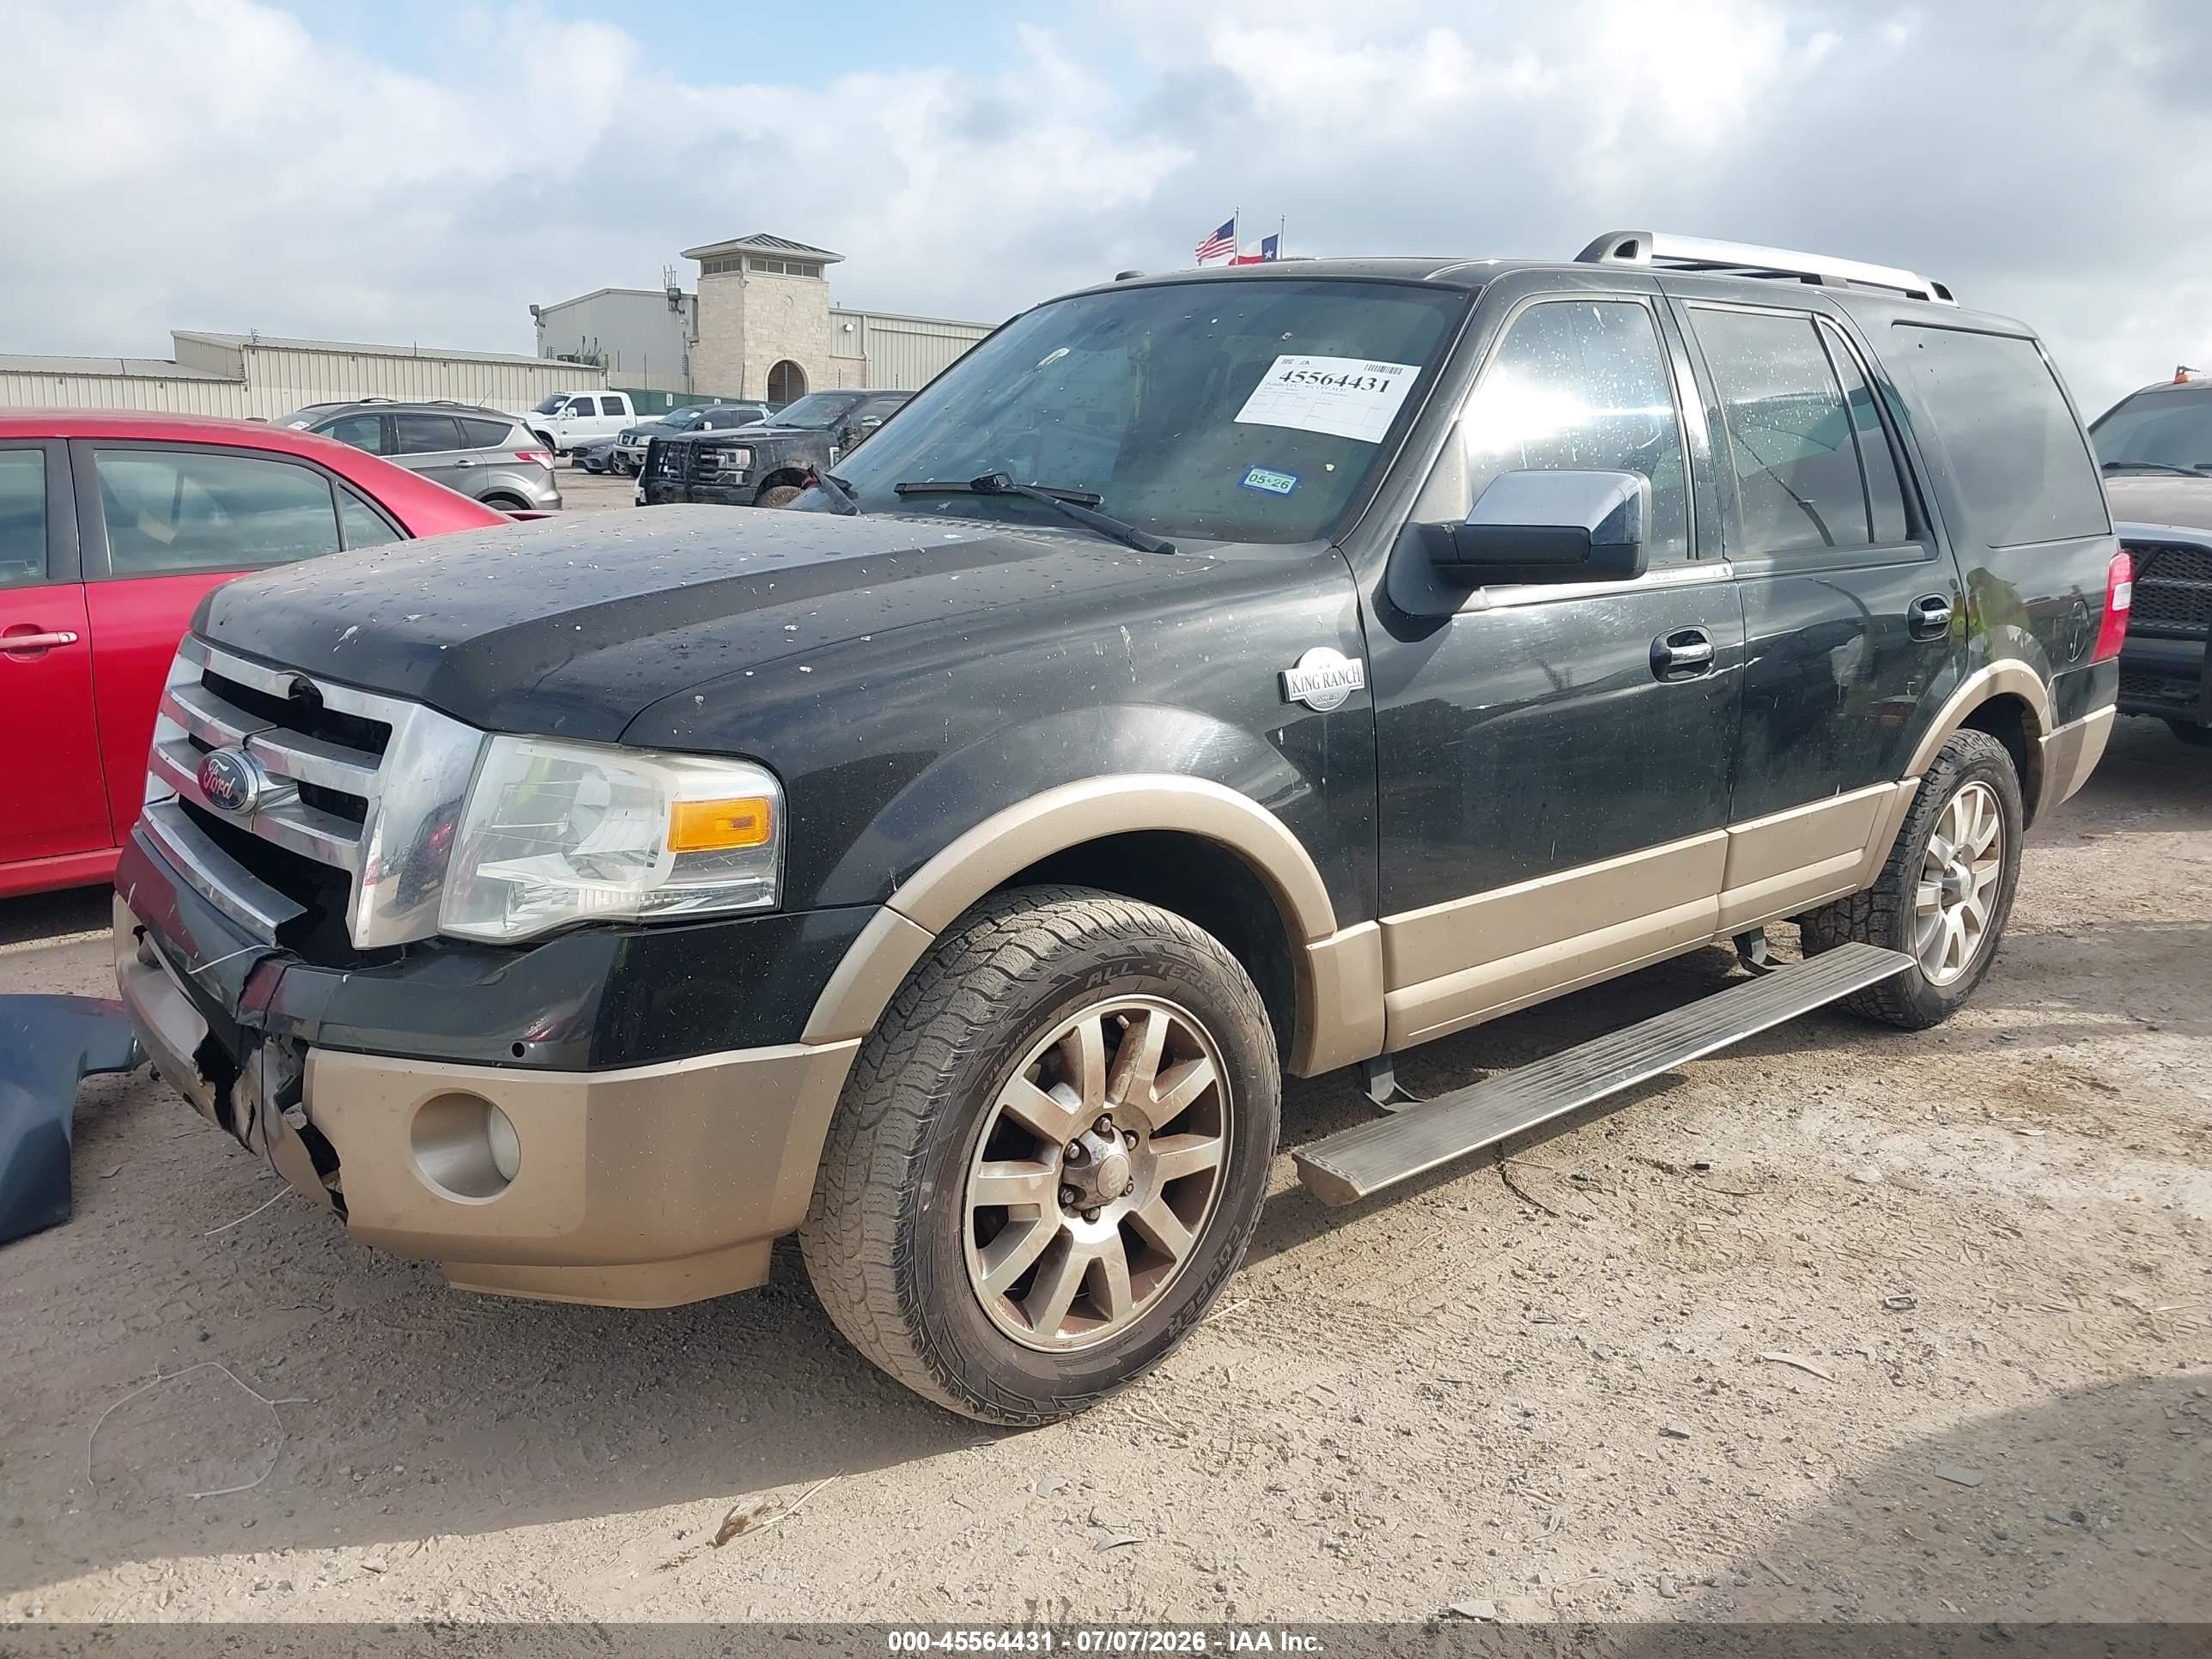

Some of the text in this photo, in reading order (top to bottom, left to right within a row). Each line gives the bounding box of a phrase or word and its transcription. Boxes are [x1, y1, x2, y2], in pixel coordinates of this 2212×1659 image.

[1279, 370, 1391, 393] 45564431
[1291, 665, 1361, 694] KING RANCH
[203, 758, 236, 799] Ford
[1168, 1224, 1242, 1338] COOPER
